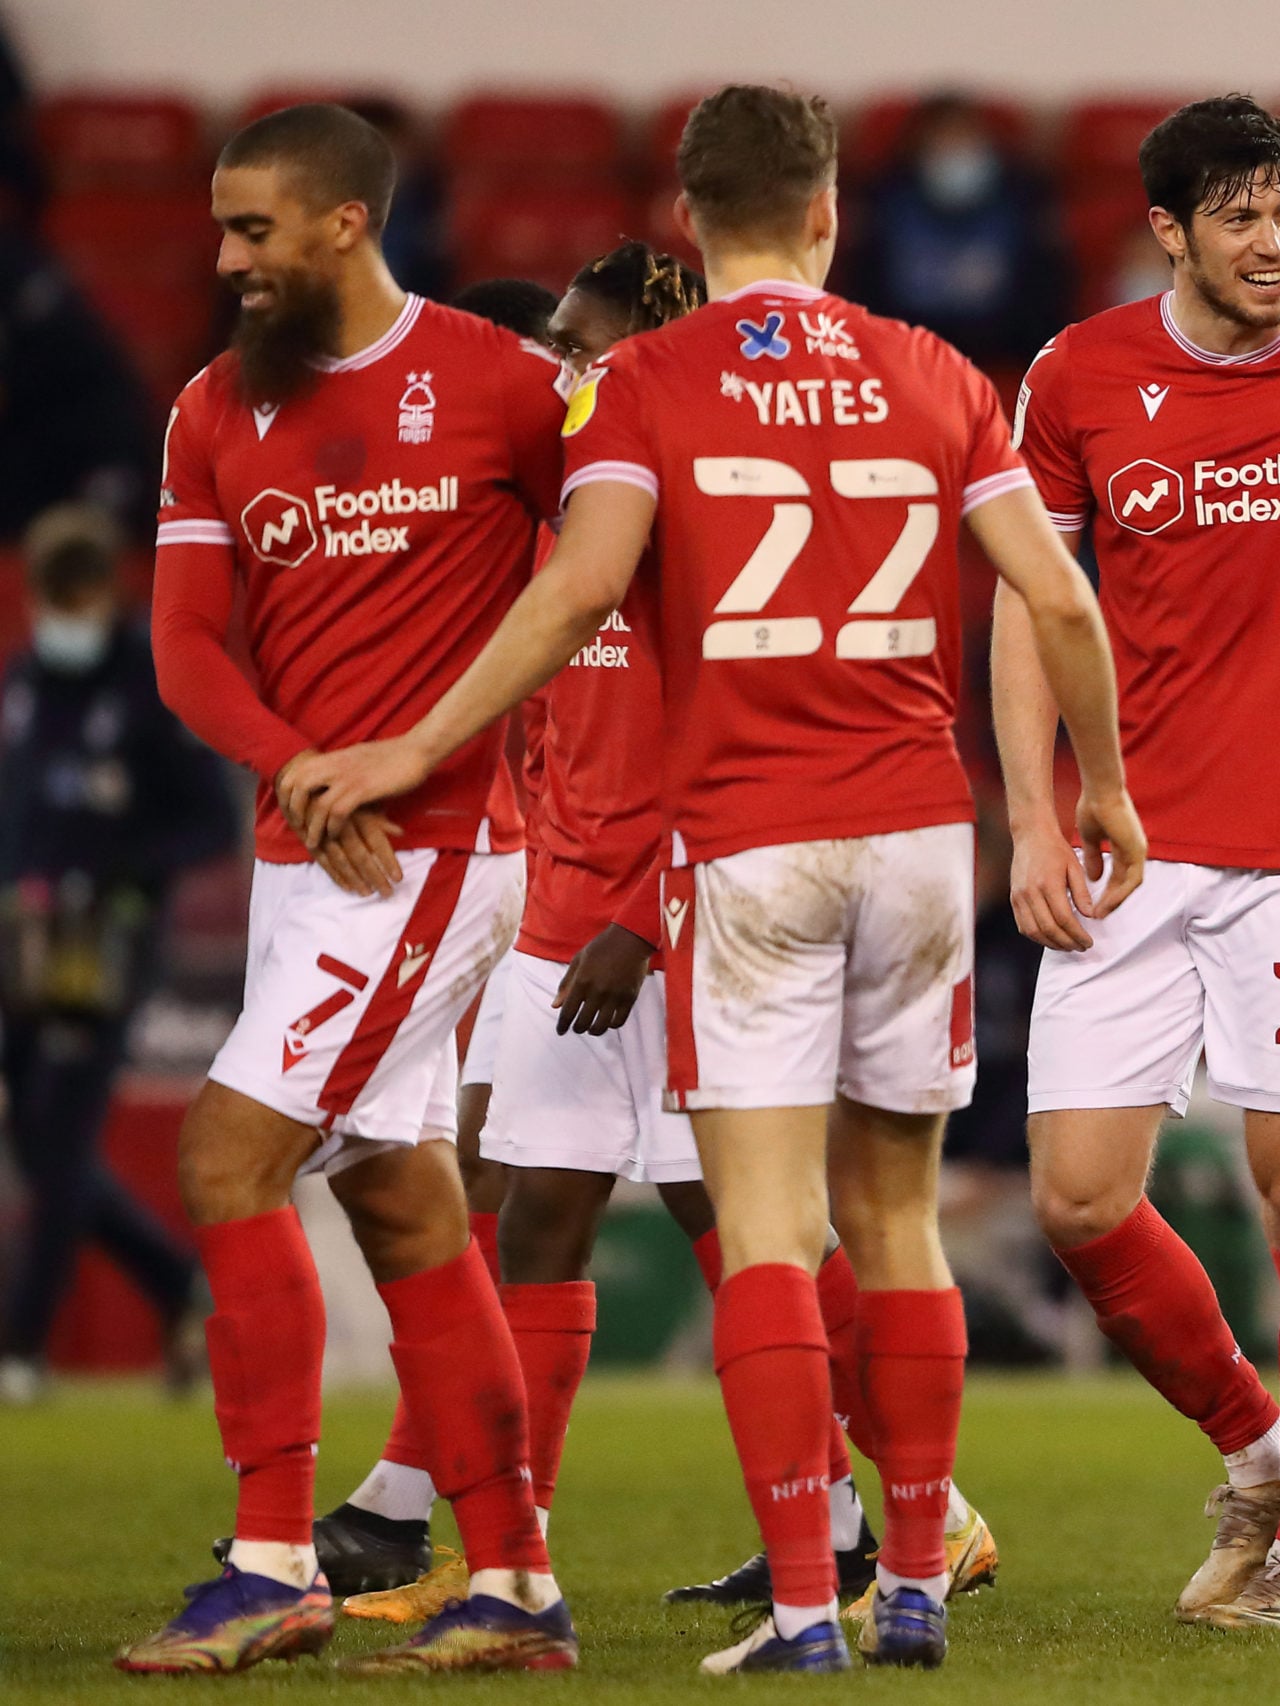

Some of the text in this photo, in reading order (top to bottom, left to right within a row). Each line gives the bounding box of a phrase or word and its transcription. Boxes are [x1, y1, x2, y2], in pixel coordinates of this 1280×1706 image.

[798, 311, 854, 344] UK
[745, 379, 889, 425] YATES
[315, 477, 458, 521] Football
[323, 520, 409, 557] Index
[694, 457, 938, 660] 22
[288, 952, 370, 1037] 7
